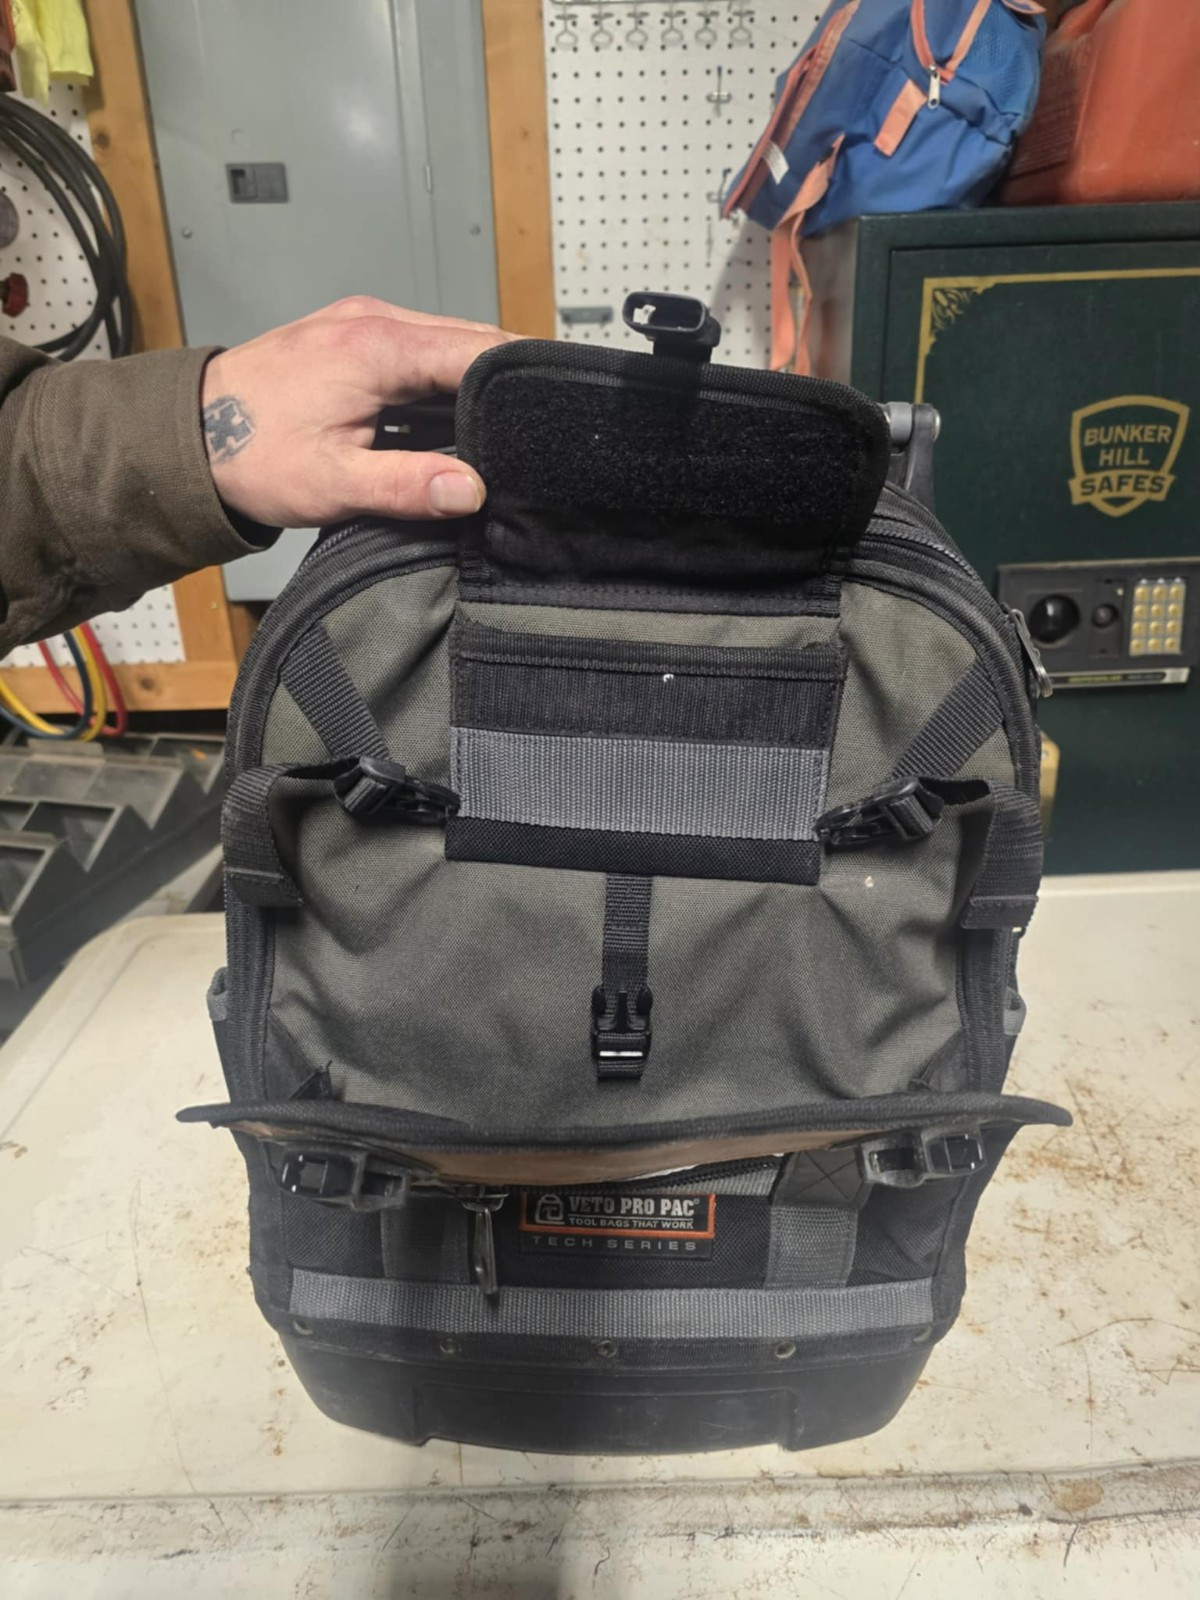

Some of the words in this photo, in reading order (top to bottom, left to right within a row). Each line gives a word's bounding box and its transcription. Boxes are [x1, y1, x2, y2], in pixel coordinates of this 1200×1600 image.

[1084, 424, 1172, 446] BUNKER
[1099, 447, 1150, 467] HILL
[1081, 474, 1166, 496] SAFES
[569, 1196, 614, 1214] VETO
[620, 1197, 655, 1216] PRO
[569, 1217, 597, 1227] TOOL
[600, 1219, 630, 1228] BAGS
[632, 1220, 659, 1229] THAT
[661, 1220, 694, 1230] WORK
[532, 1236, 593, 1248] TECH
[606, 1239, 697, 1251] SERIES
